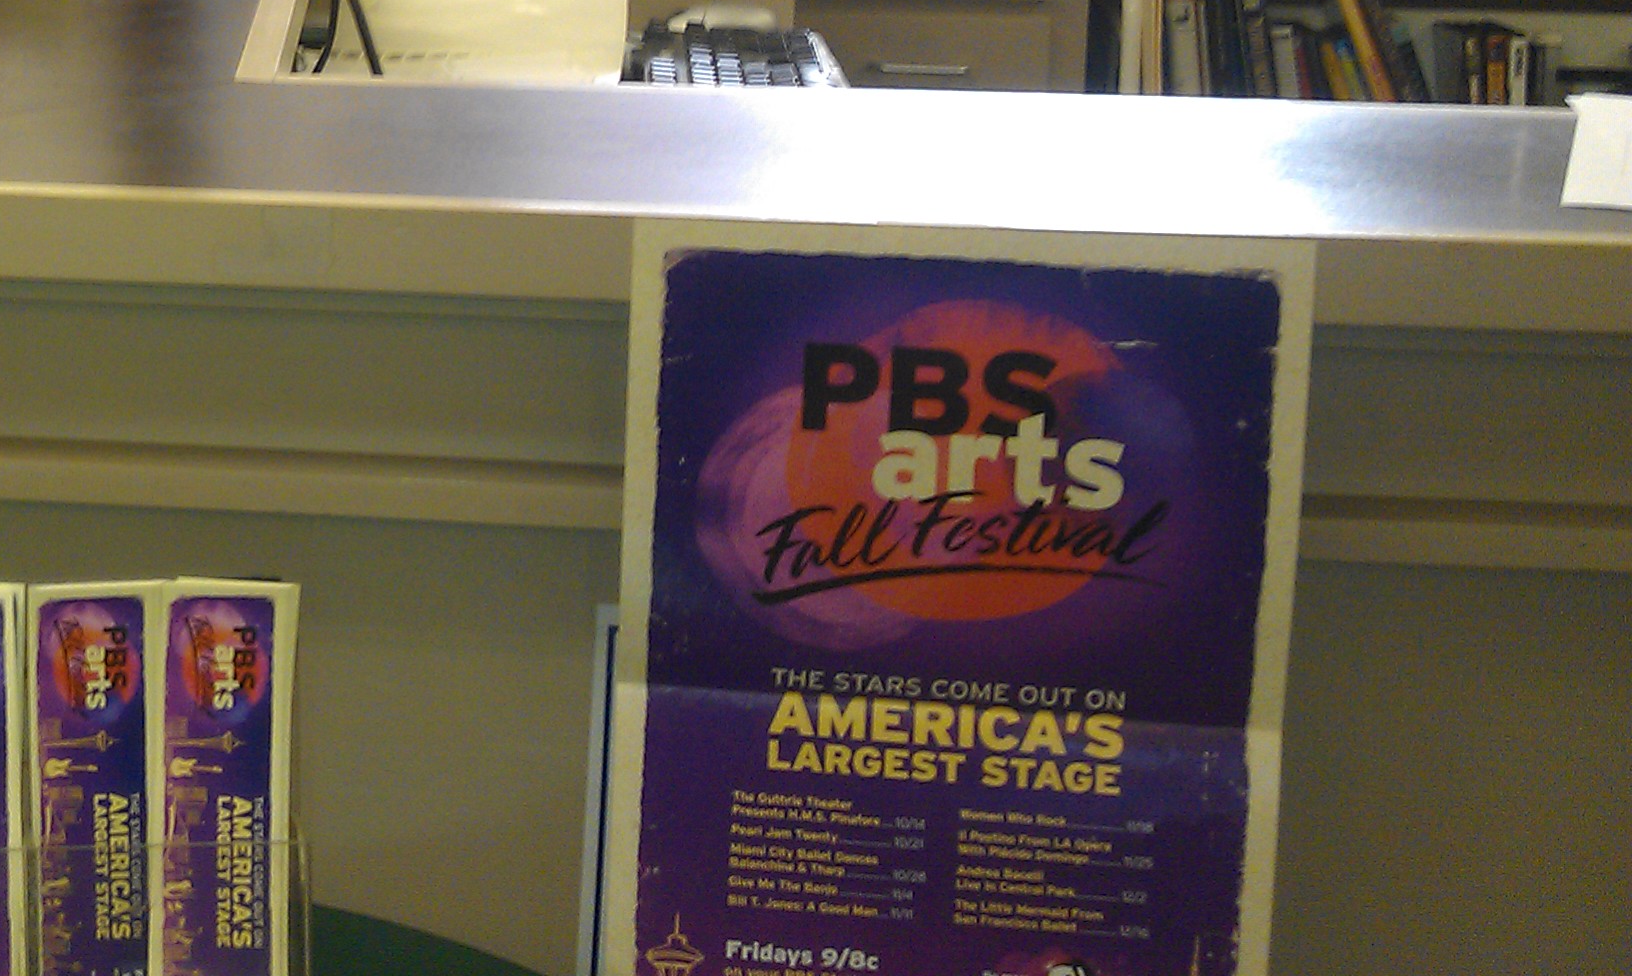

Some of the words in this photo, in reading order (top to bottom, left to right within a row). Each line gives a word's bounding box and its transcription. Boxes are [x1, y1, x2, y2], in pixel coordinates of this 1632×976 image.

[802, 342, 1058, 439] PBS
[870, 411, 1126, 512] arts
[755, 499, 906, 584] Fall
[911, 489, 1169, 565] Festival
[85, 644, 113, 710] arts
[103, 626, 127, 688] PBS
[212, 644, 240, 711] arts
[233, 626, 256, 690] PBS
[770, 667, 825, 690] THE
[832, 672, 923, 698] STARS
[930, 678, 1011, 704] COME
[1018, 684, 1077, 708] OUT
[1084, 687, 1127, 711] ON
[768, 690, 1125, 760] AMERICA'S
[767, 738, 968, 784] LARGEST
[980, 754, 1123, 797] STAGE
[93, 793, 109, 877] LARGEST
[108, 792, 131, 940] AMERICA'S
[216, 794, 231, 882] LARGEST
[232, 795, 253, 949] AMERICA'S
[95, 881, 110, 940] STAGE
[216, 886, 231, 949] STAGE
[725, 938, 814, 968] Fridays
[820, 946, 880, 971] 9/8c
